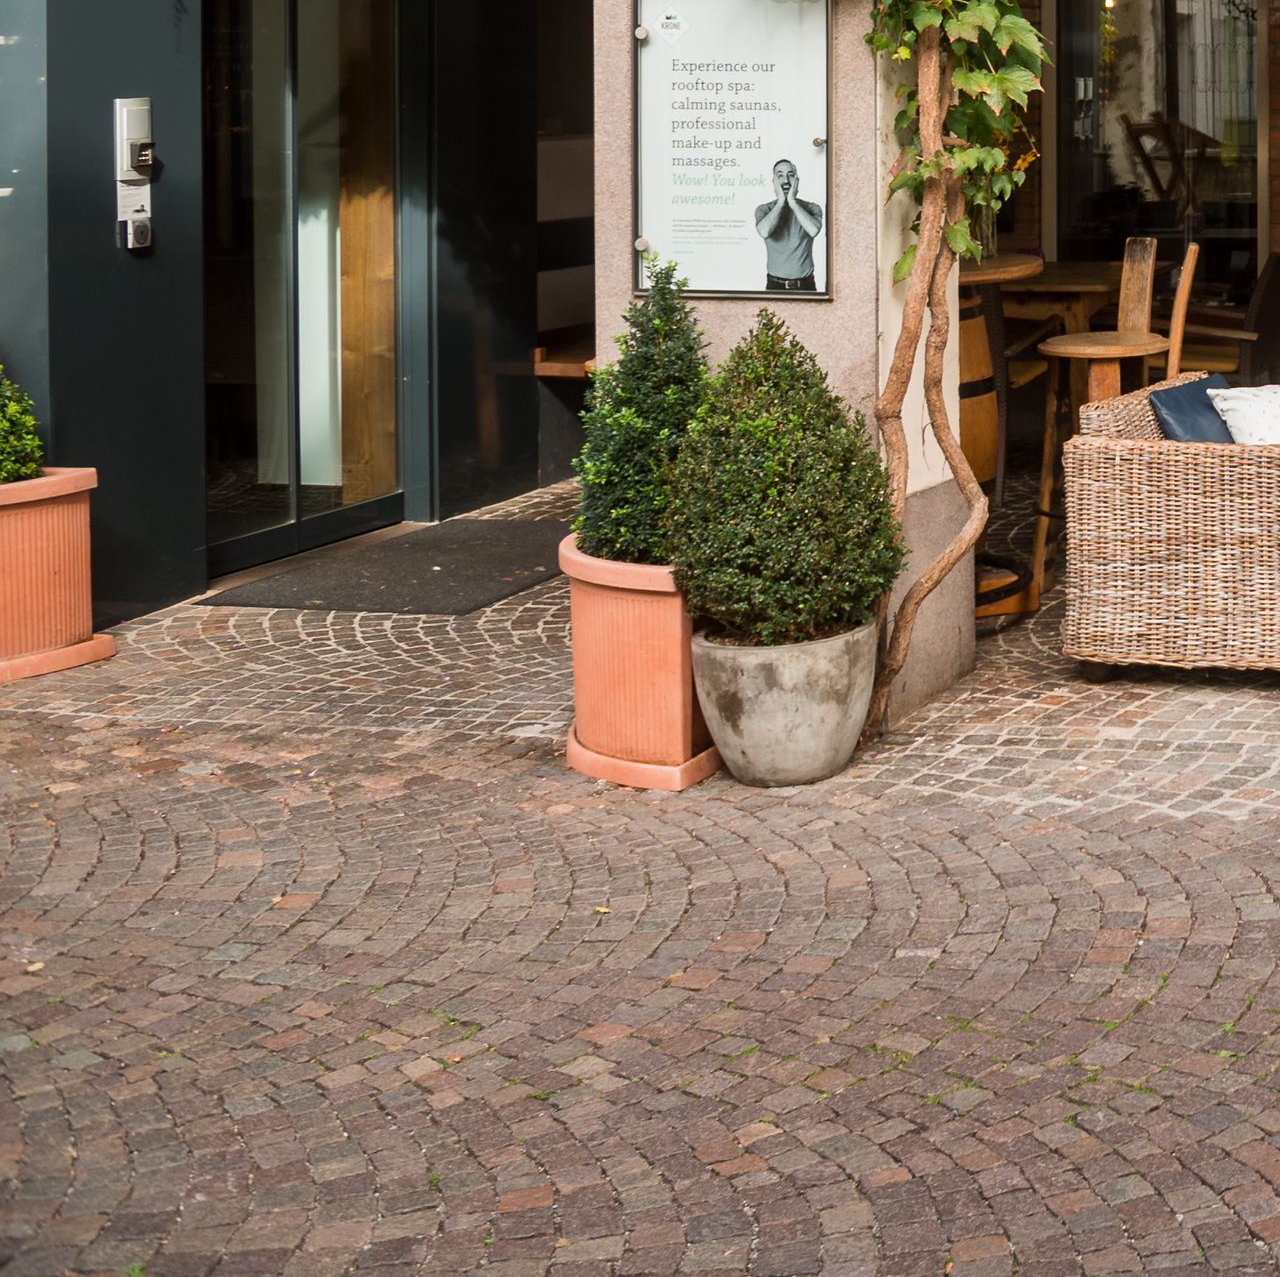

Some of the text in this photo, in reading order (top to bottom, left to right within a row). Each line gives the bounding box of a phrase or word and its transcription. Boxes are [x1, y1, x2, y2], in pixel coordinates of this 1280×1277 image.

[671, 58, 776, 75] Experience our
[671, 78, 756, 95] rooftop spa:
[671, 97, 782, 114] calming saunas,
[671, 116, 757, 133] professional
[671, 135, 762, 152] make-up and
[671, 156, 741, 171] massages.
[671, 173, 767, 187] Wow! You look
[671, 193, 736, 205] awesome!
